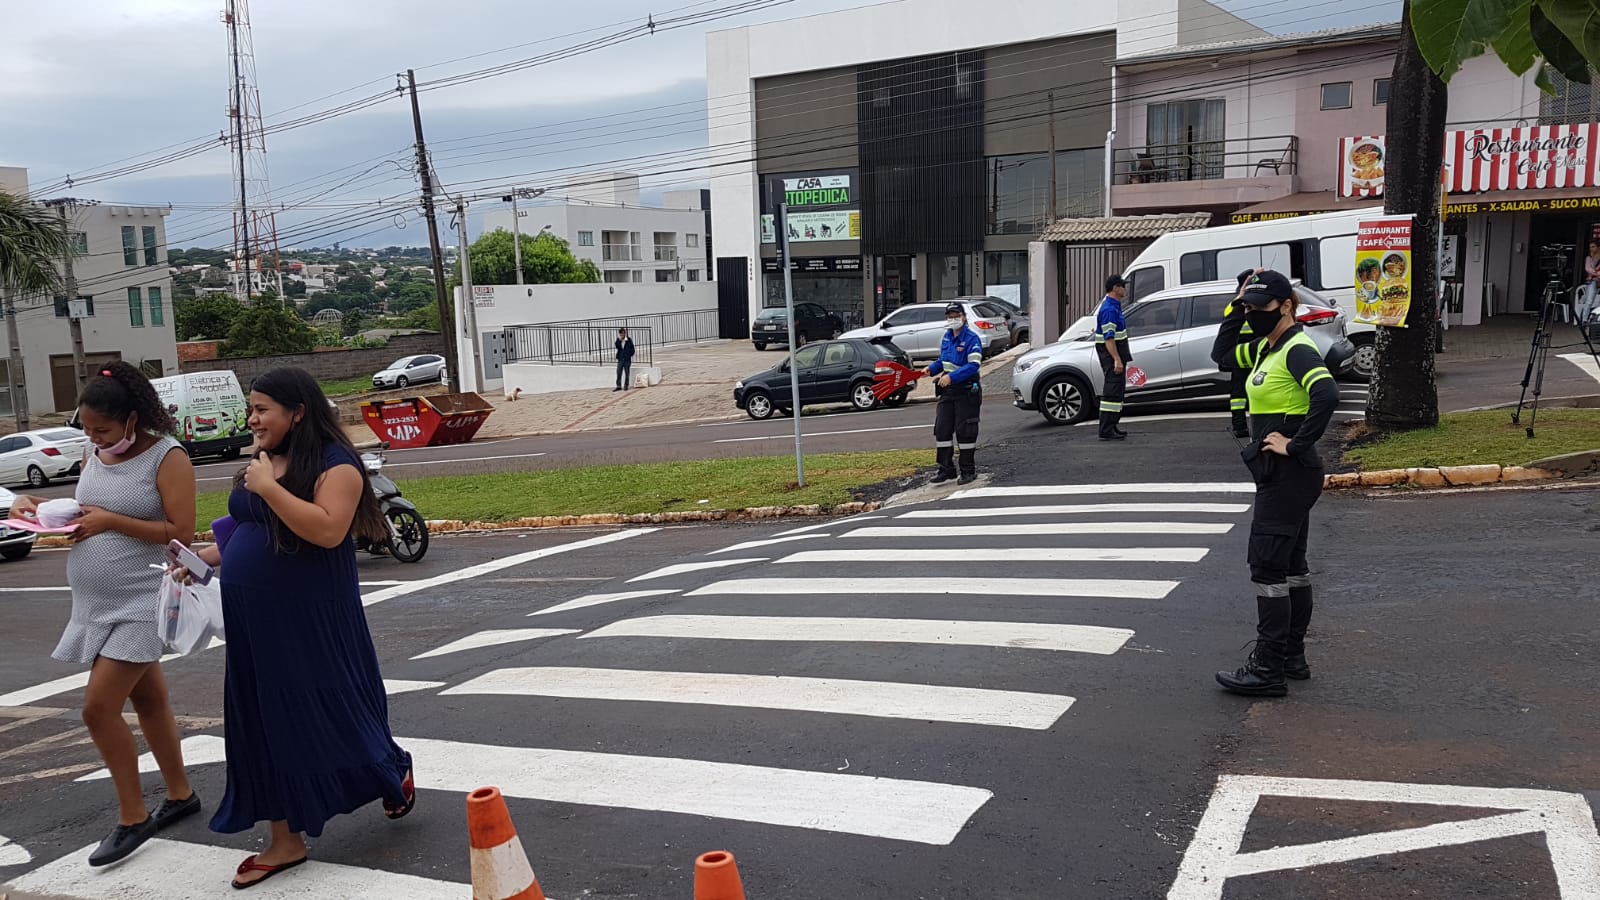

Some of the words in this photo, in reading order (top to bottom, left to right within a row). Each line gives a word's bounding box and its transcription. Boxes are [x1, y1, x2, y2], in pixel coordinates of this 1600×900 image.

[1465, 132, 1585, 161] Restaurante
[1517, 158, 1552, 178] Café
[797, 178, 822, 189] CASA
[1489, 201, 1540, 212] X-SALADA
[1550, 199, 1579, 209] SUCO
[1231, 213, 1252, 224] CAFÉ
[1358, 226, 1410, 235] RESTAURANTE
[1363, 238, 1384, 246] CAFÉ
[1128, 368, 1144, 384] PARE
[387, 424, 421, 441] LAPA
